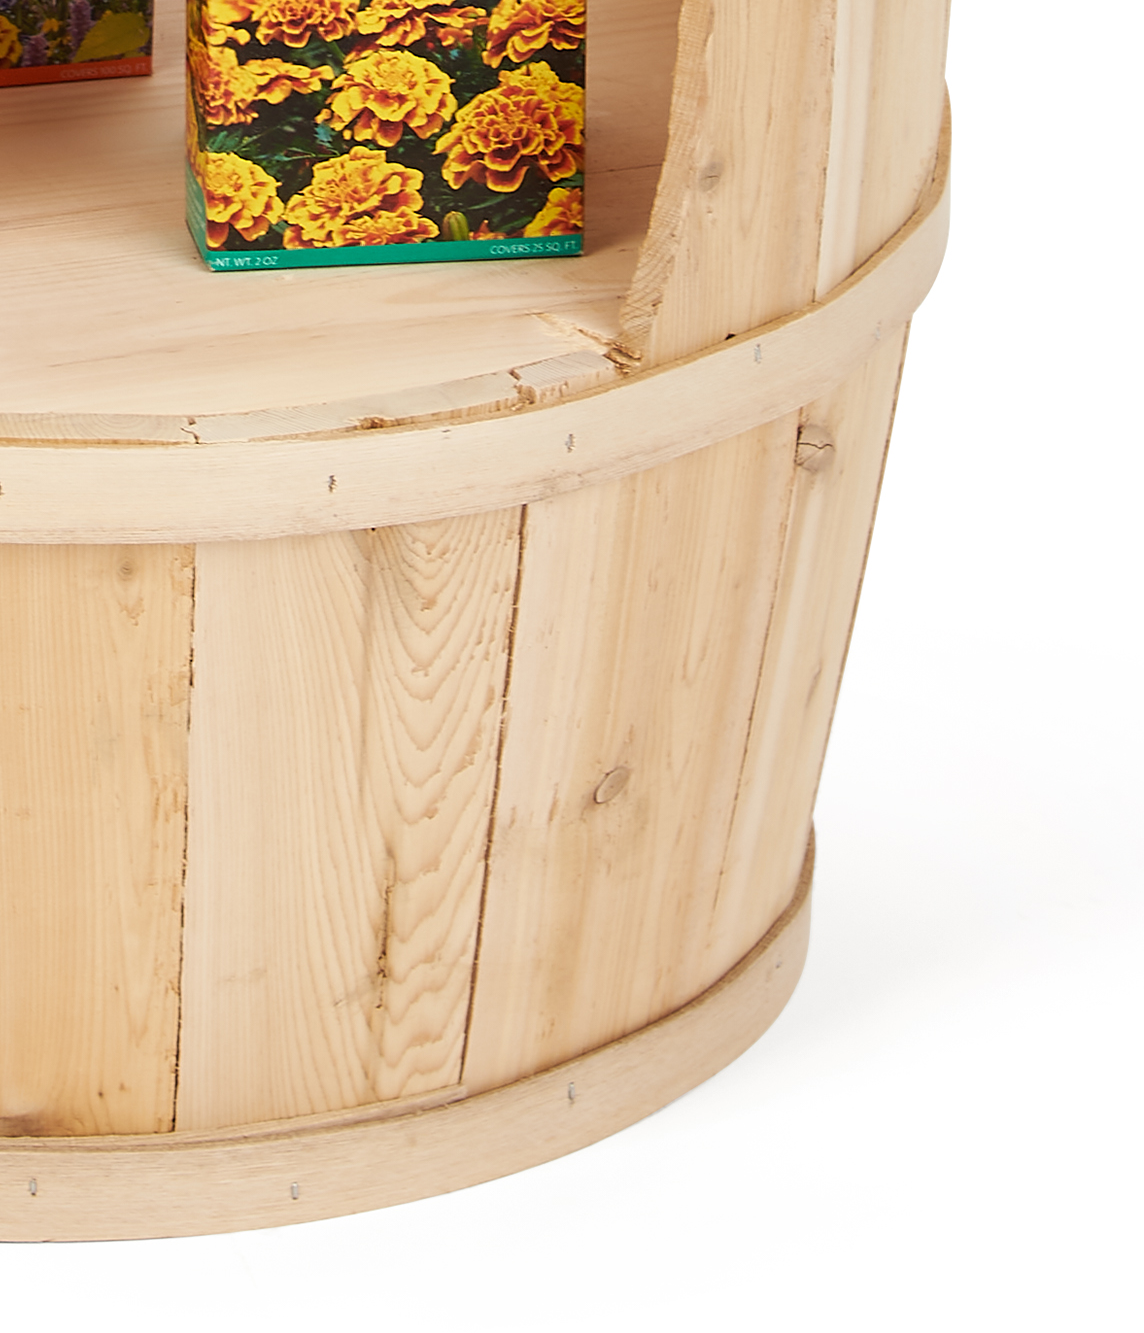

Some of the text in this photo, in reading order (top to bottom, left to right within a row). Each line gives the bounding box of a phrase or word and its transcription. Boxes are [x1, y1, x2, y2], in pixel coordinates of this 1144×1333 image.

[490, 244, 530, 255] COVERS
[255, 257, 261, 266] 2
[263, 256, 279, 266] OZ
